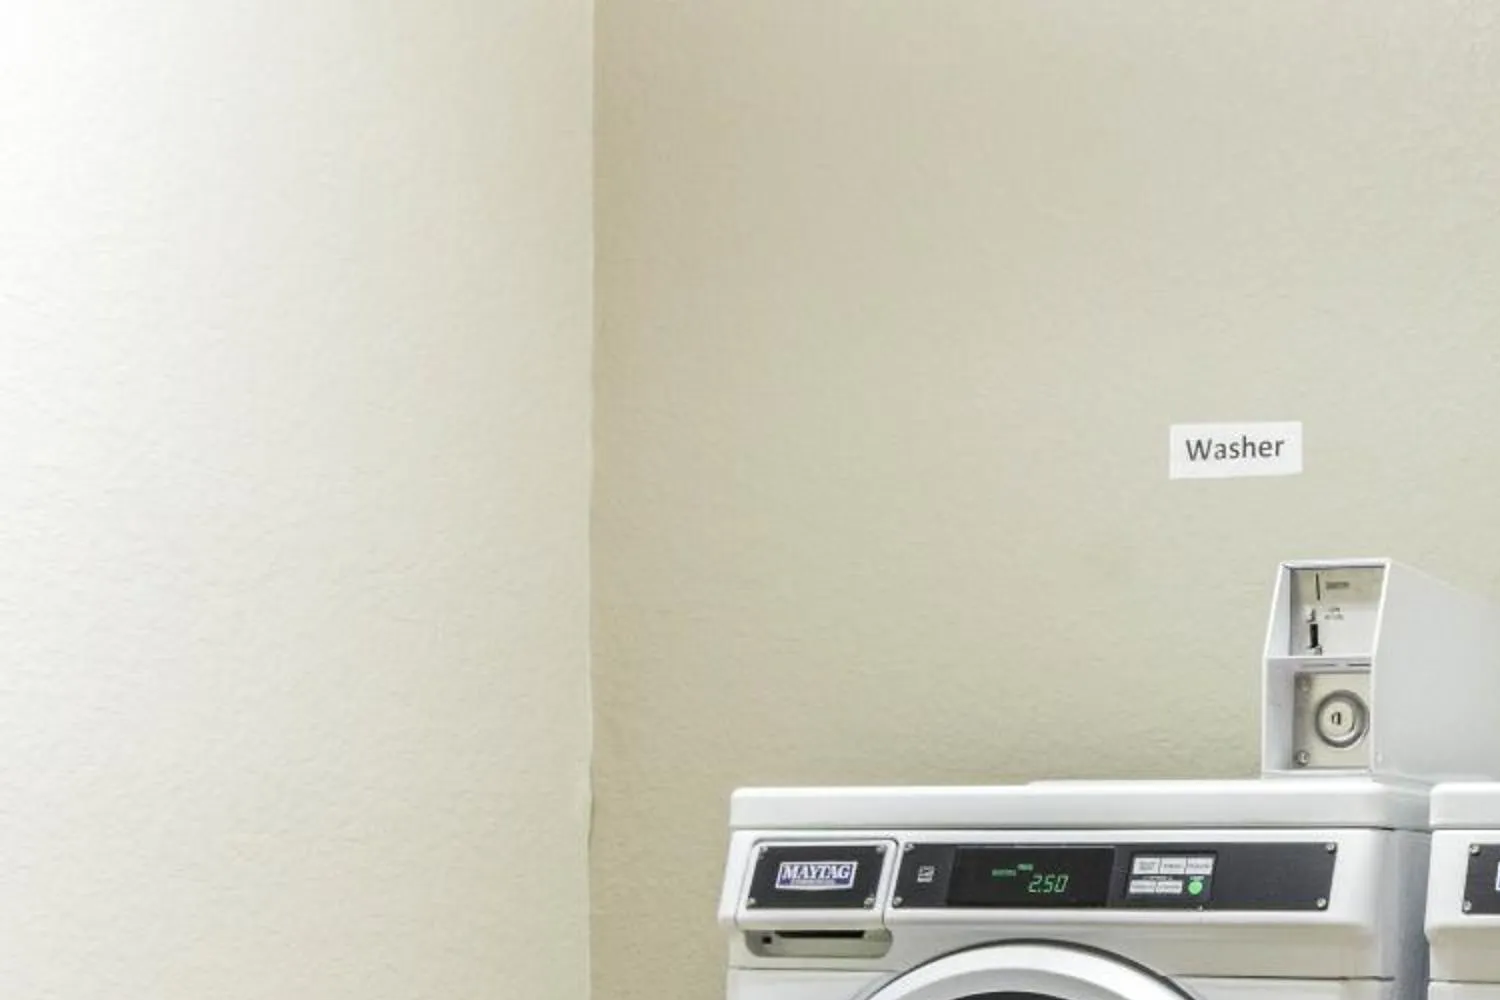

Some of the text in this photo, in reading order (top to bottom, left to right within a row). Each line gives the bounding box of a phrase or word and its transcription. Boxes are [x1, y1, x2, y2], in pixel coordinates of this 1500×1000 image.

[1185, 434, 1285, 461] Washer
[781, 864, 851, 880] MAYTAG
[1028, 873, 1069, 893] 2.50
